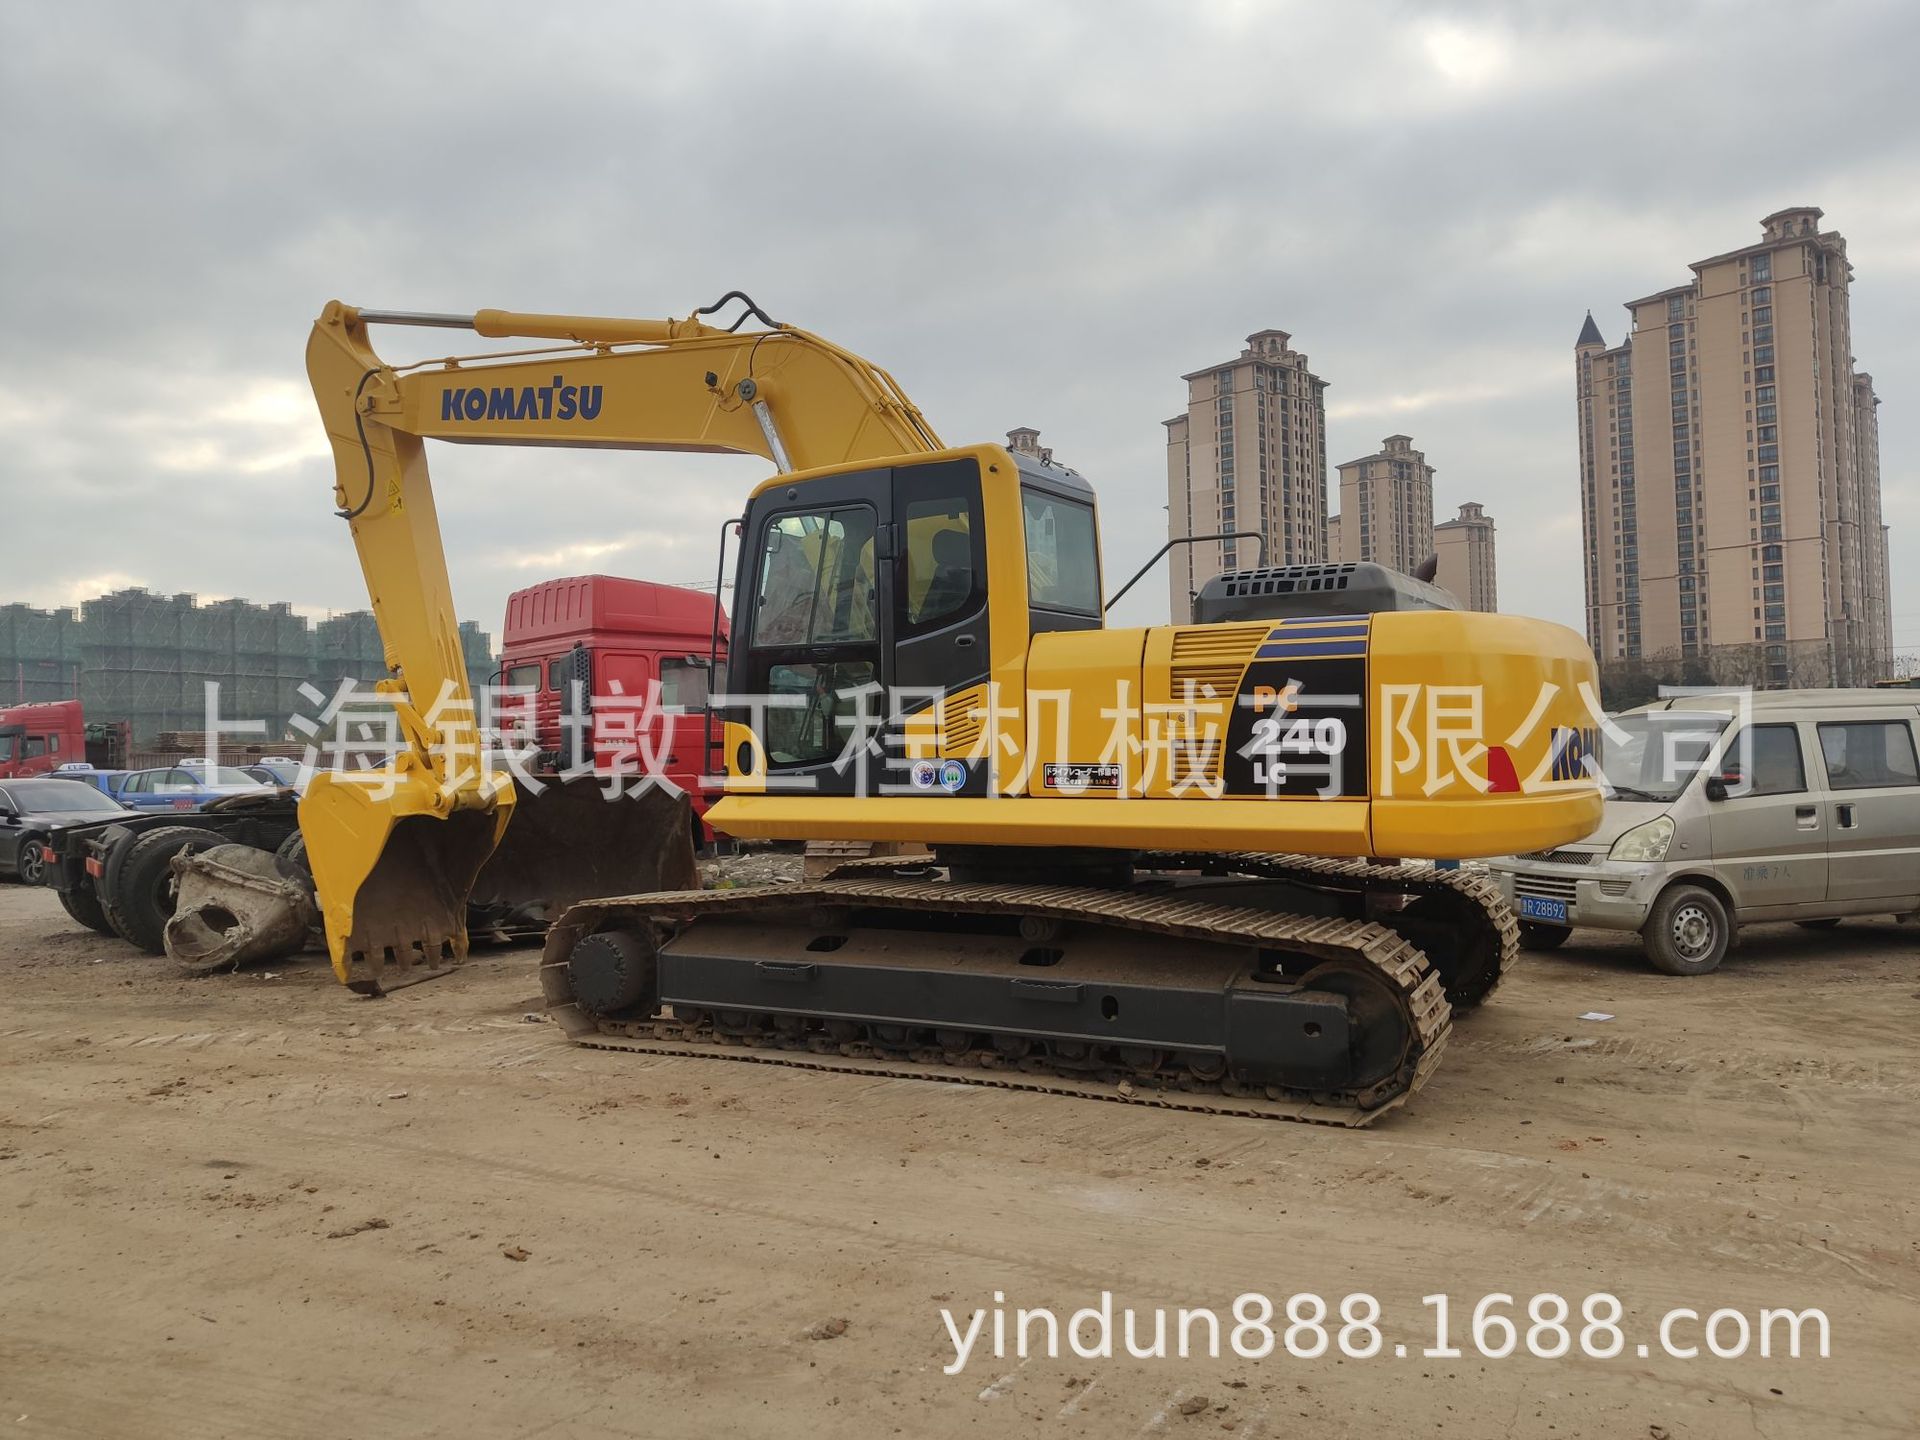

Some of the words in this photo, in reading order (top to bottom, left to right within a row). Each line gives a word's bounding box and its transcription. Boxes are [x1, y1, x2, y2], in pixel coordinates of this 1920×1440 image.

[441, 375, 603, 421] KOMATSU
[1254, 685, 1298, 712] PC
[1251, 717, 1347, 756] 240
[1253, 762, 1287, 785] LC
